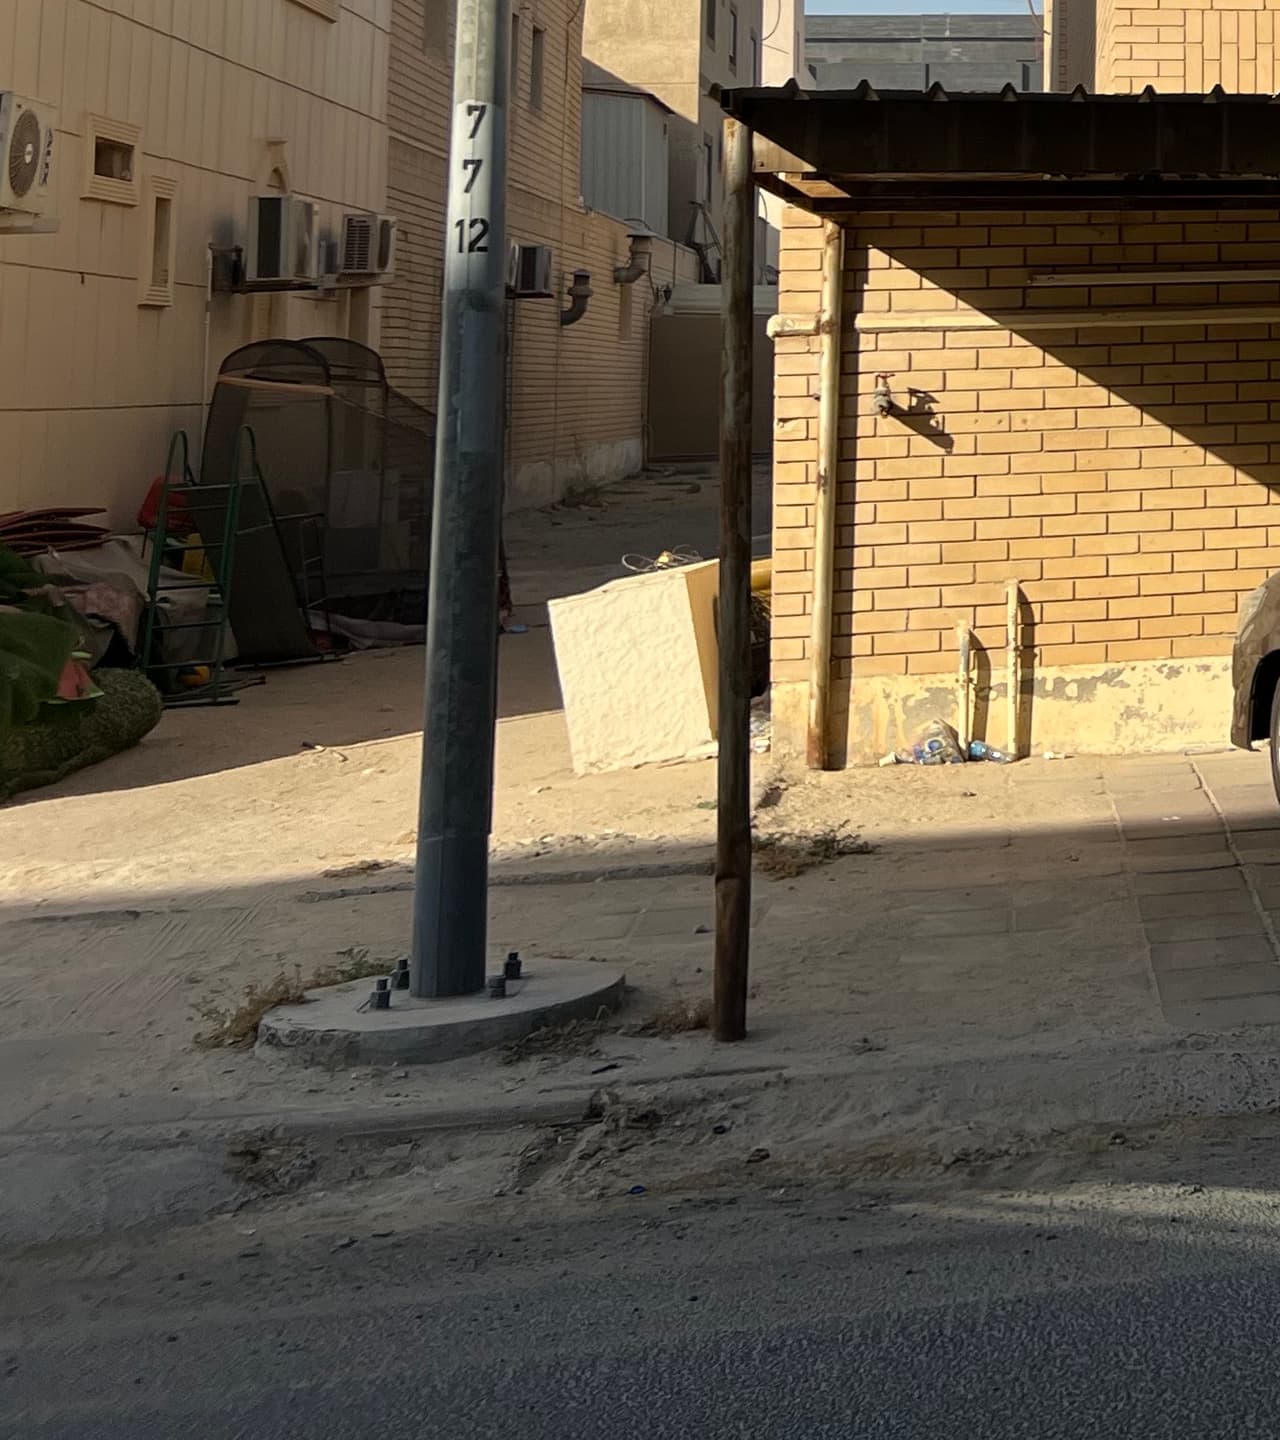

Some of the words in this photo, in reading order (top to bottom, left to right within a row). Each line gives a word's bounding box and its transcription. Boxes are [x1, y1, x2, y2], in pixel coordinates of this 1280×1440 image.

[467, 105, 486, 139] 7
[462, 159, 483, 194] 7
[454, 218, 490, 254] 12
